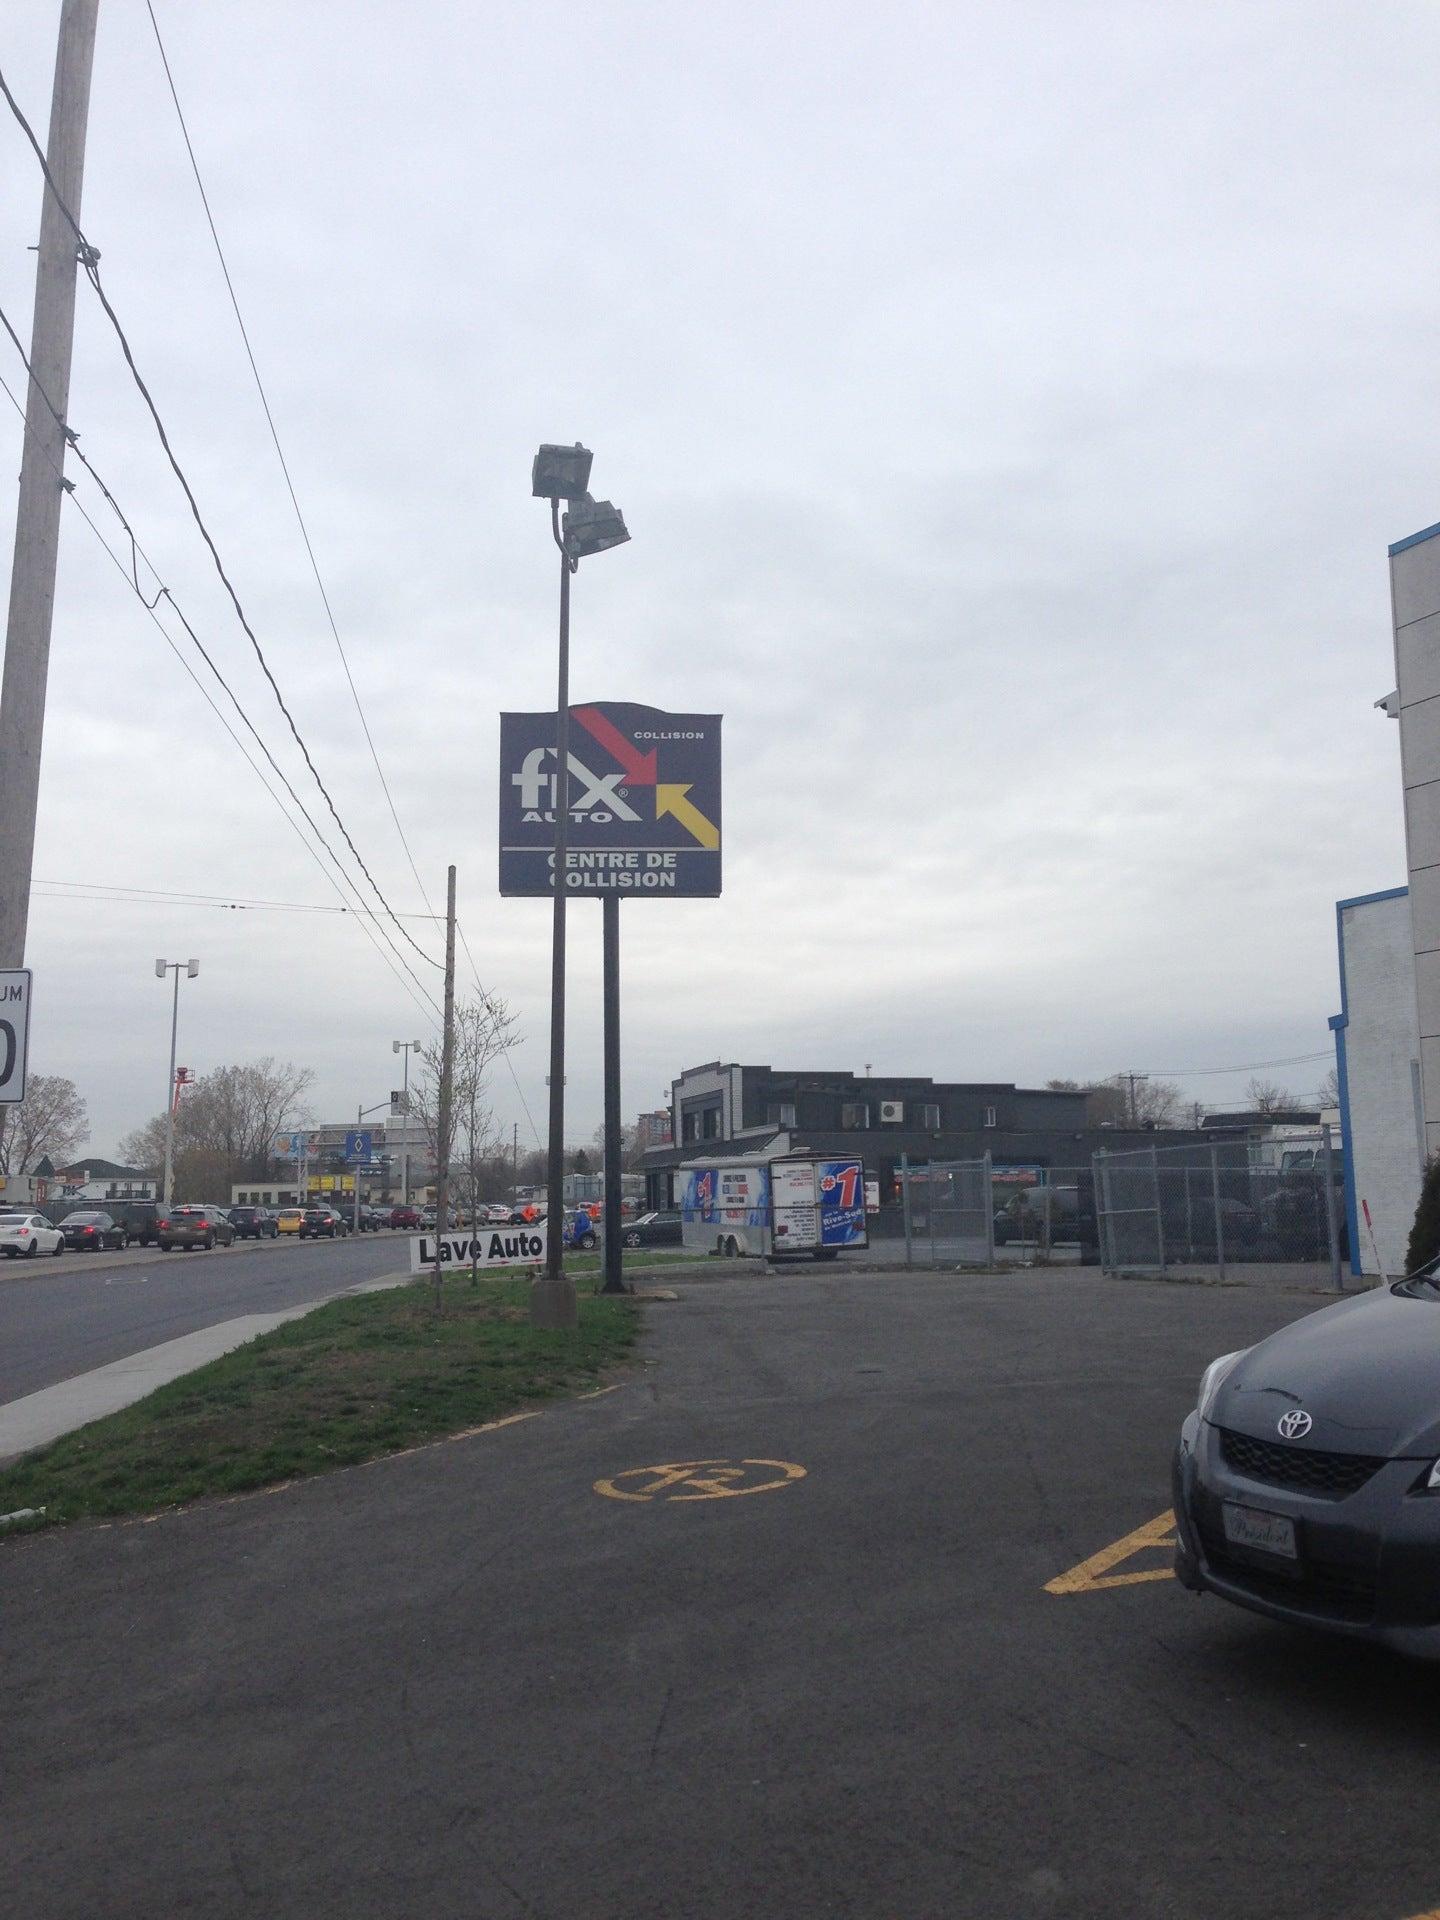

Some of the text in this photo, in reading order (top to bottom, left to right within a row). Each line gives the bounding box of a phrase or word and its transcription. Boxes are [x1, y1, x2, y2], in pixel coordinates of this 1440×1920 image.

[633, 731, 705, 740] COLLISION
[646, 853, 677, 868] DE
[820, 1165, 860, 1208] #1
[419, 1232, 543, 1263] Lave Auto
